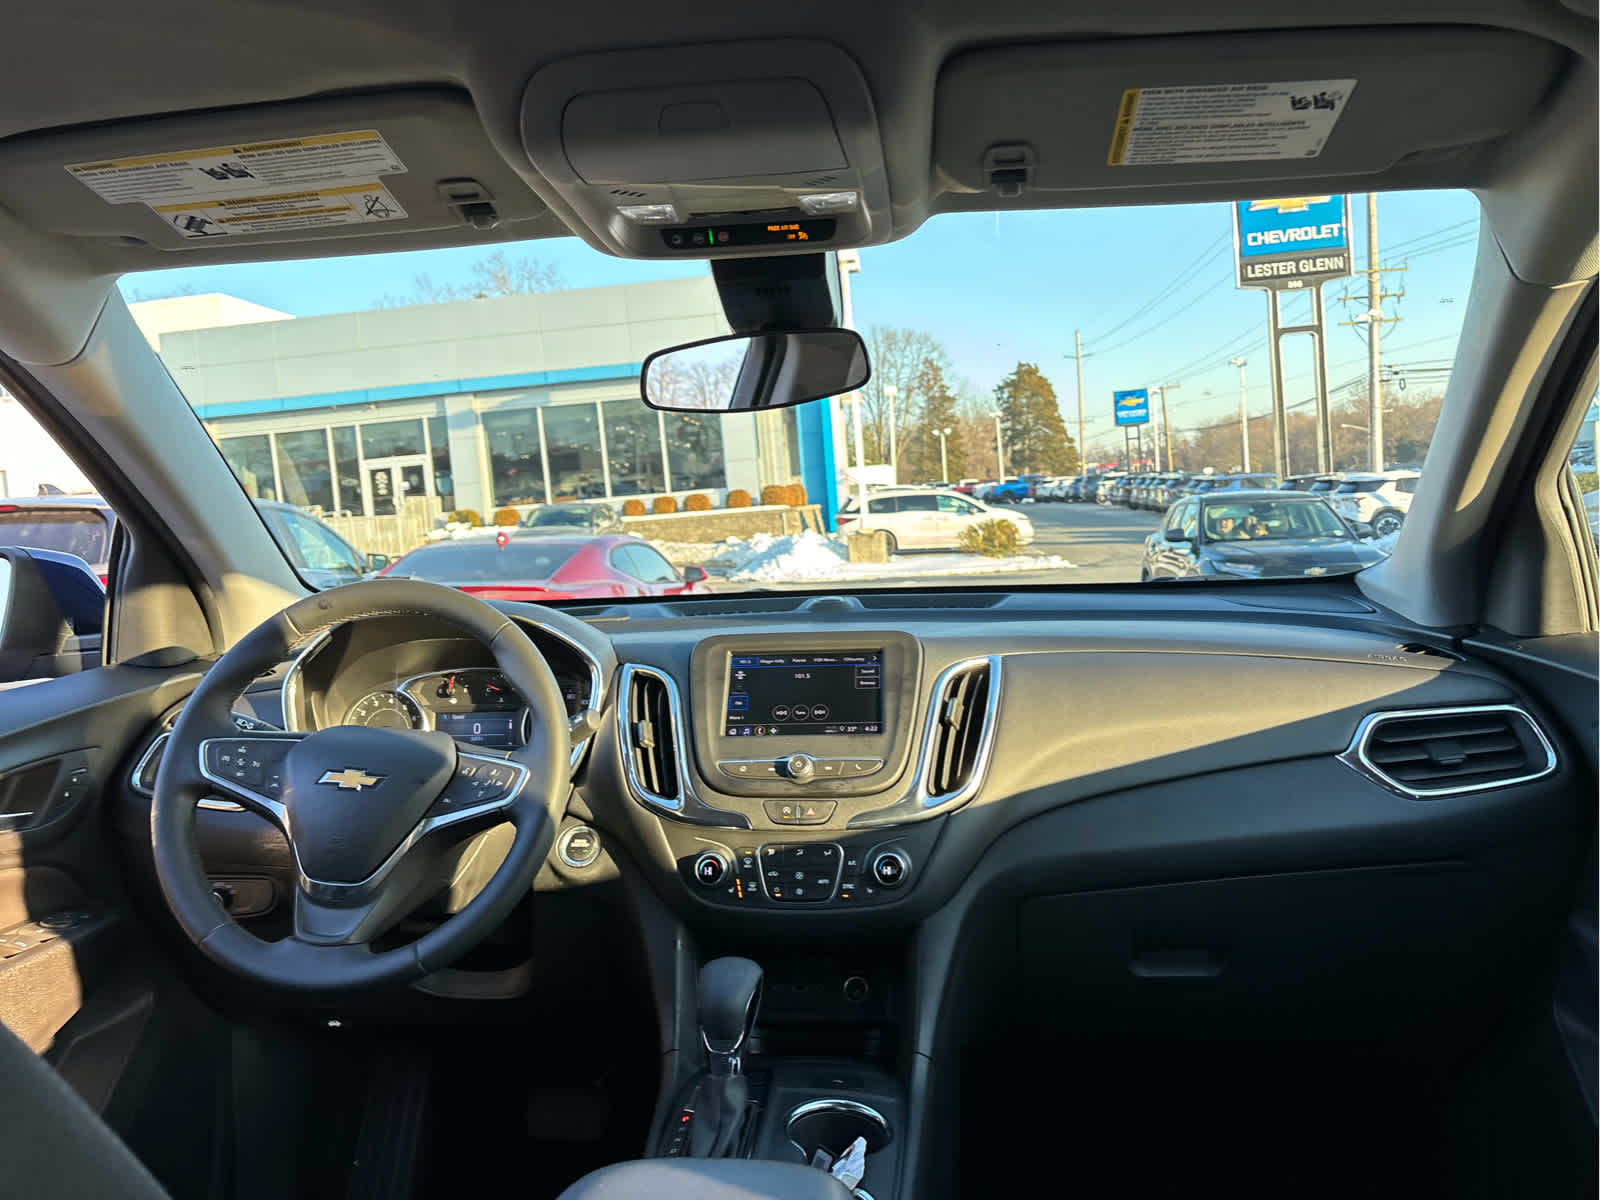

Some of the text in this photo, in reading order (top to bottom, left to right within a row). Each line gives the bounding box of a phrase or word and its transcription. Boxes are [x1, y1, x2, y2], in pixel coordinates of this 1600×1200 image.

[1247, 223, 1341, 247] CHEVROLET
[1247, 256, 1344, 278] LESTER GLENN
